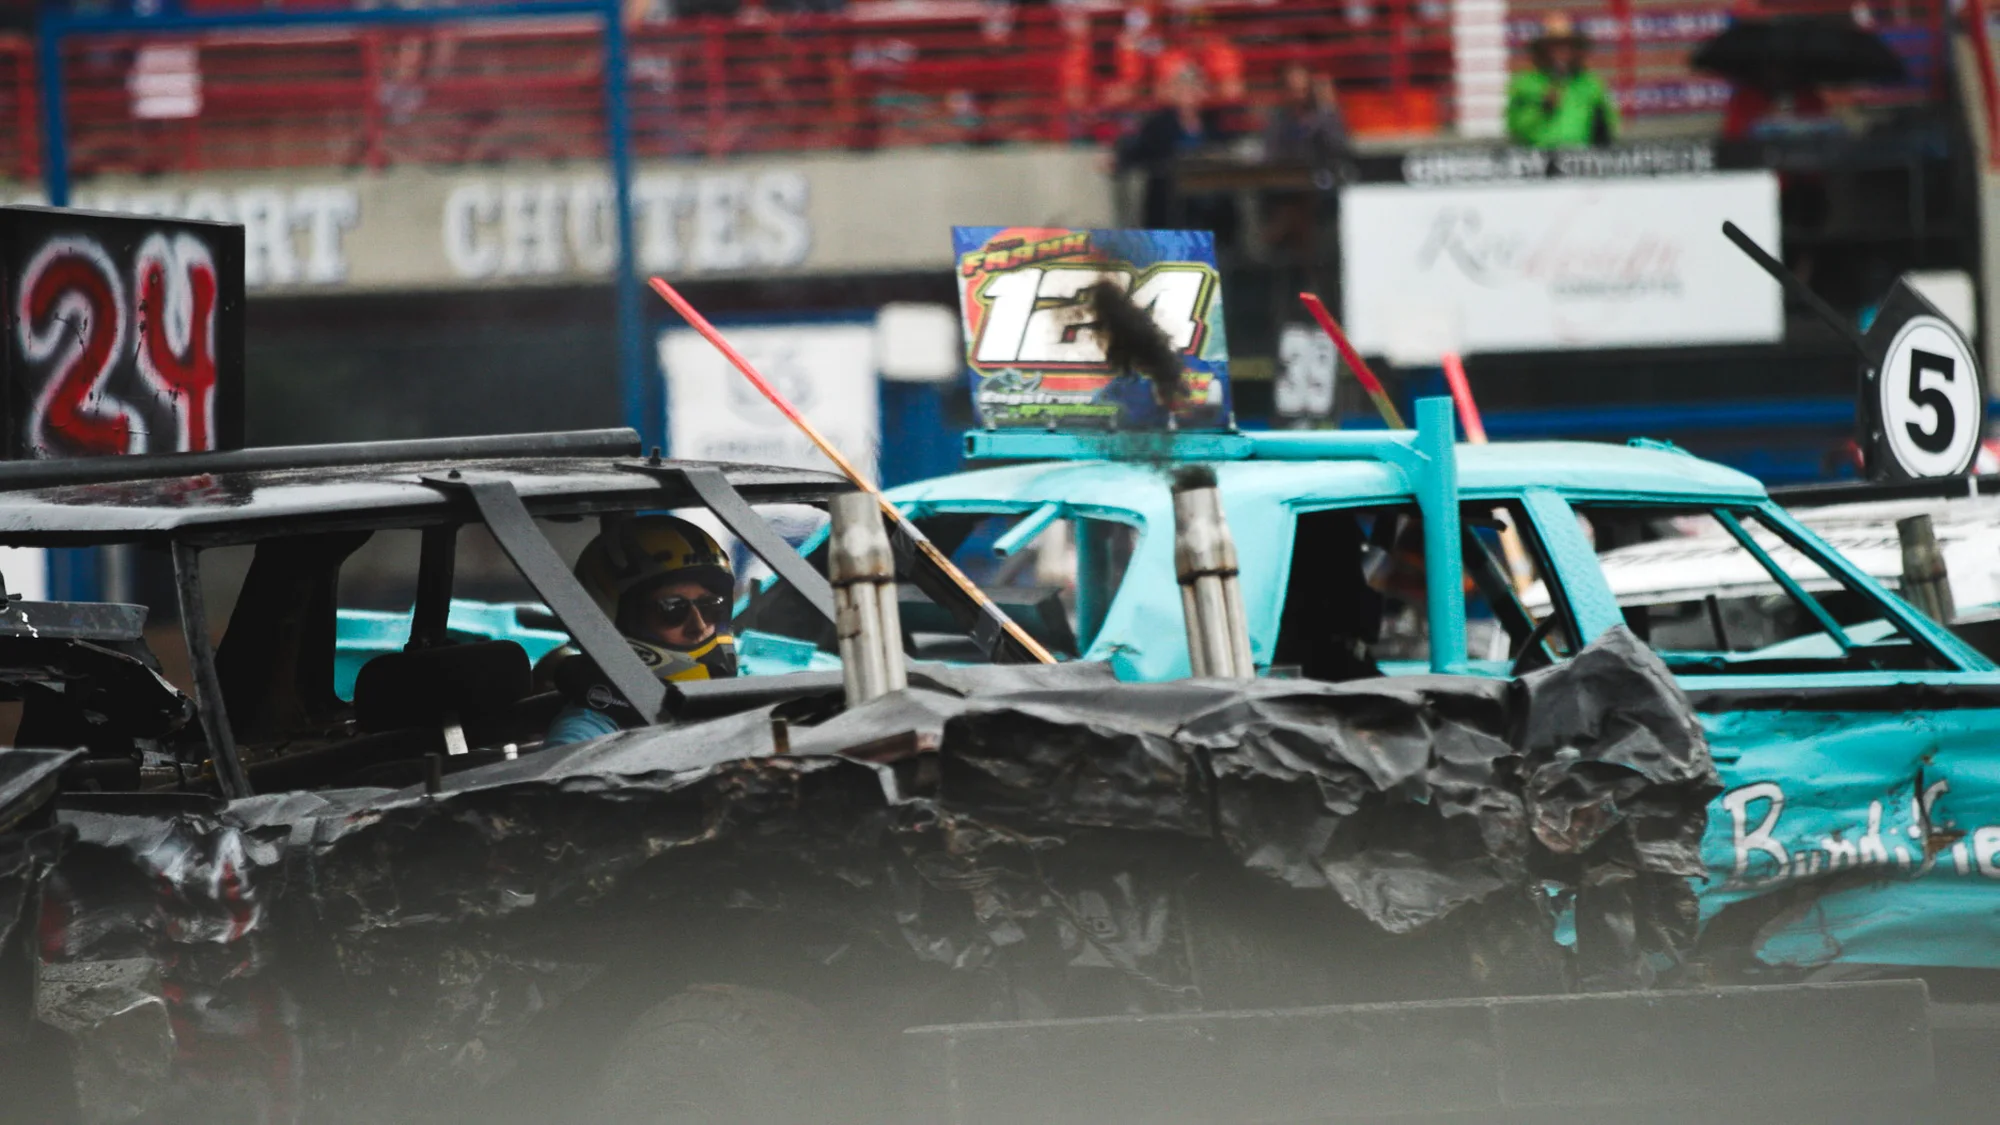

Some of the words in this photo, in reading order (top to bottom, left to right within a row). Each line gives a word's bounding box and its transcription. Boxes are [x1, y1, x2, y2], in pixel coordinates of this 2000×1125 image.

[442, 171, 812, 280] CHUTES
[18, 234, 216, 456] 24
[975, 266, 1206, 363] 124
[1905, 348, 1956, 455] 5
